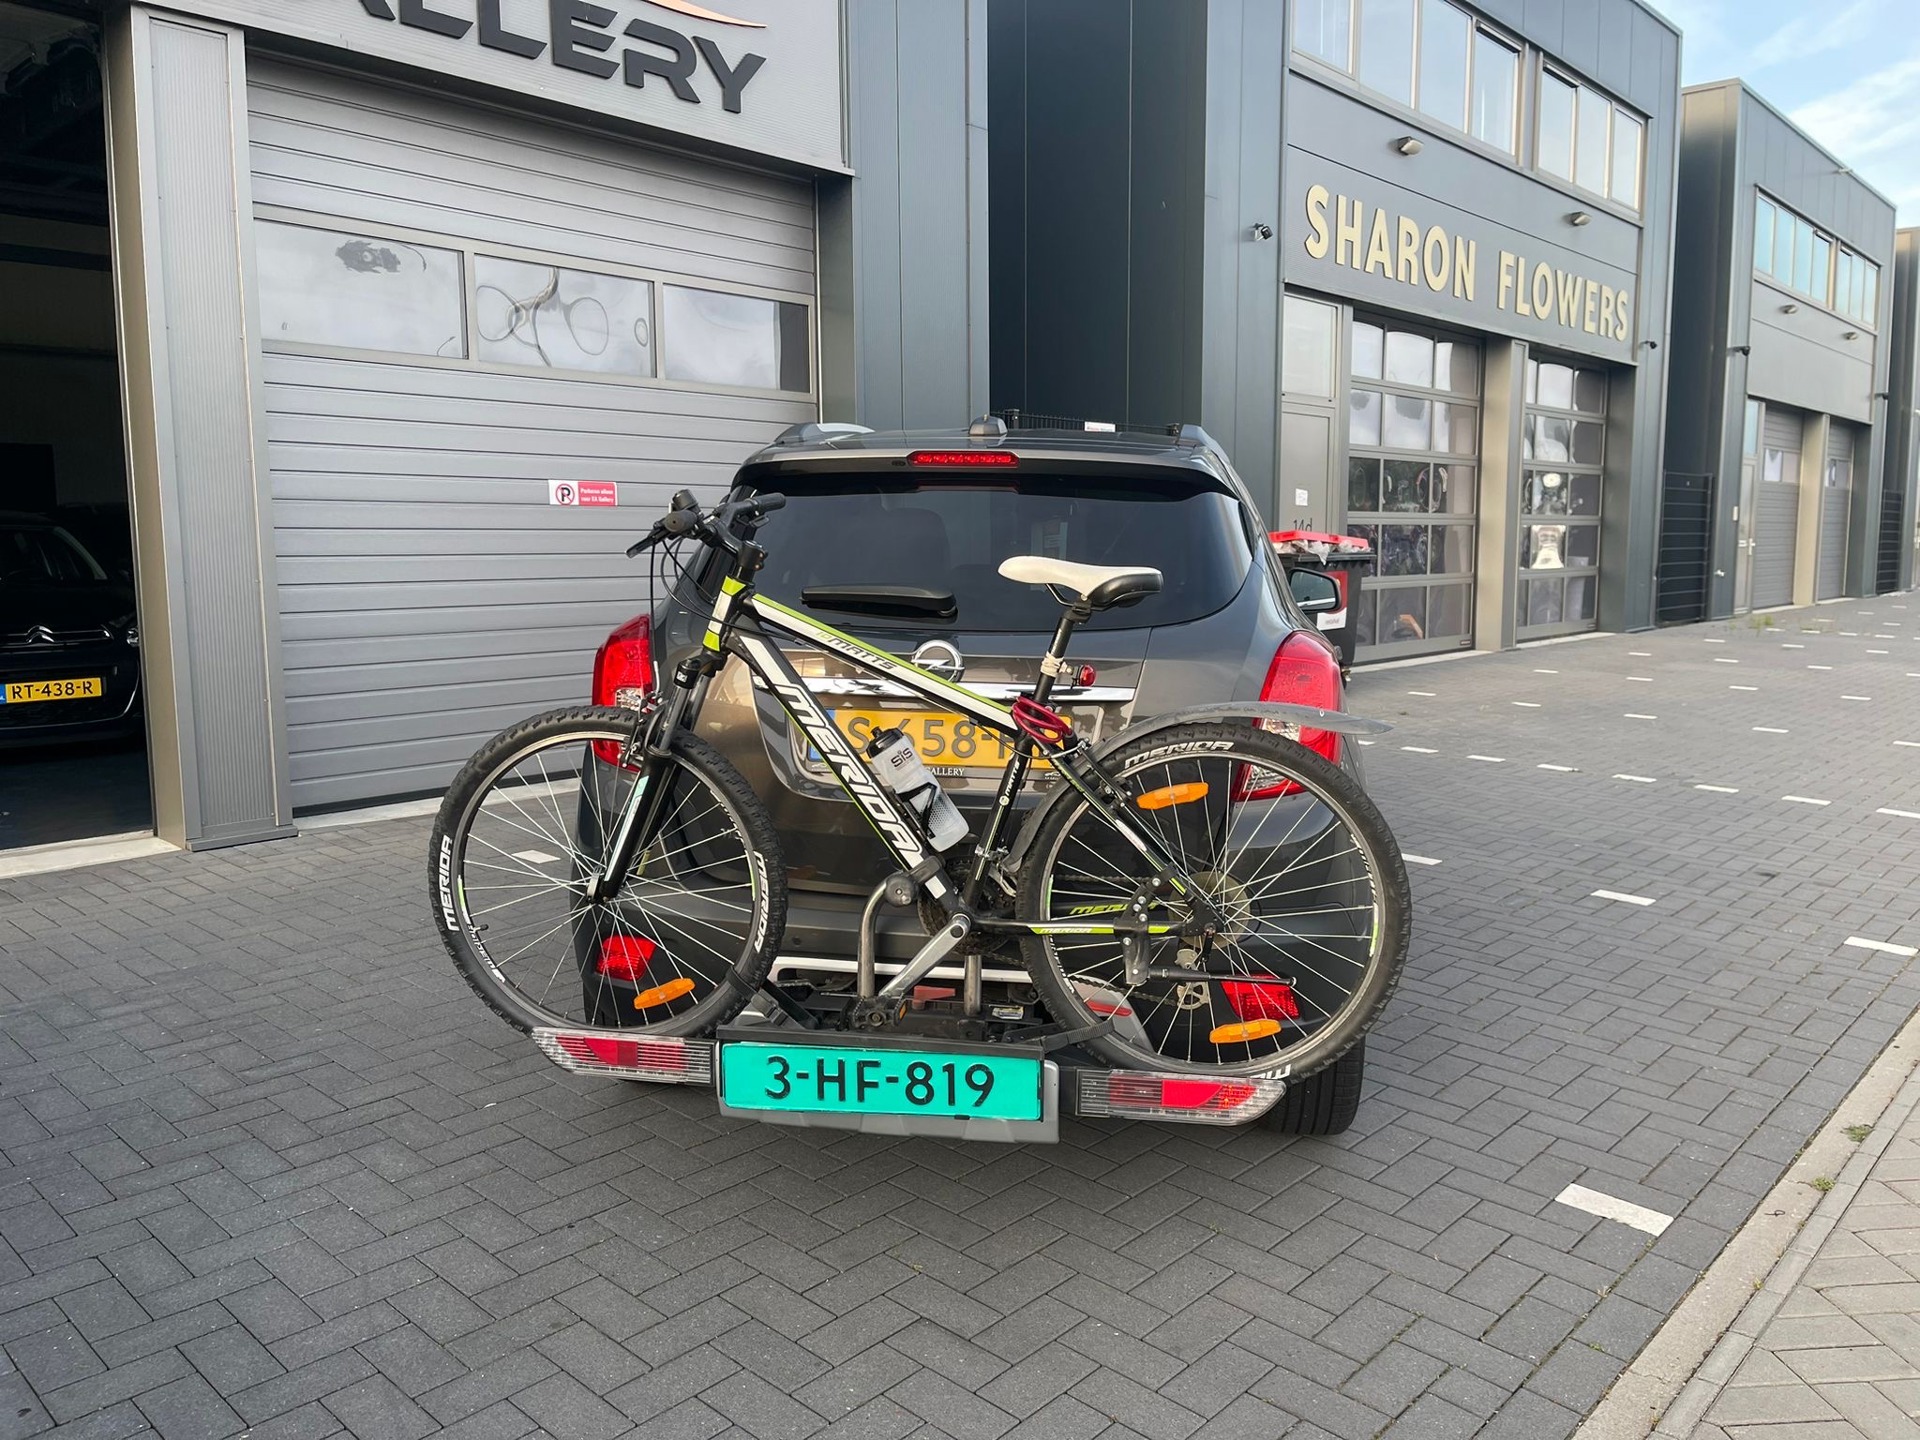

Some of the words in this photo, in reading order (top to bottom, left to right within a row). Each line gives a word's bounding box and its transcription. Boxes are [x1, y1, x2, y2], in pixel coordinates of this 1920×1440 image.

[1304, 184, 1476, 302] SHARON
[1497, 250, 1629, 342] FLOWERS
[11, 681, 94, 699] RT-438-R
[828, 637, 898, 670] MATTS
[774, 683, 923, 852] MERIDA
[1124, 741, 1236, 770] MERIDA
[439, 834, 460, 932] MERIDA
[753, 851, 769, 953] MERIDA
[765, 1055, 995, 1108] 3-HF-819
